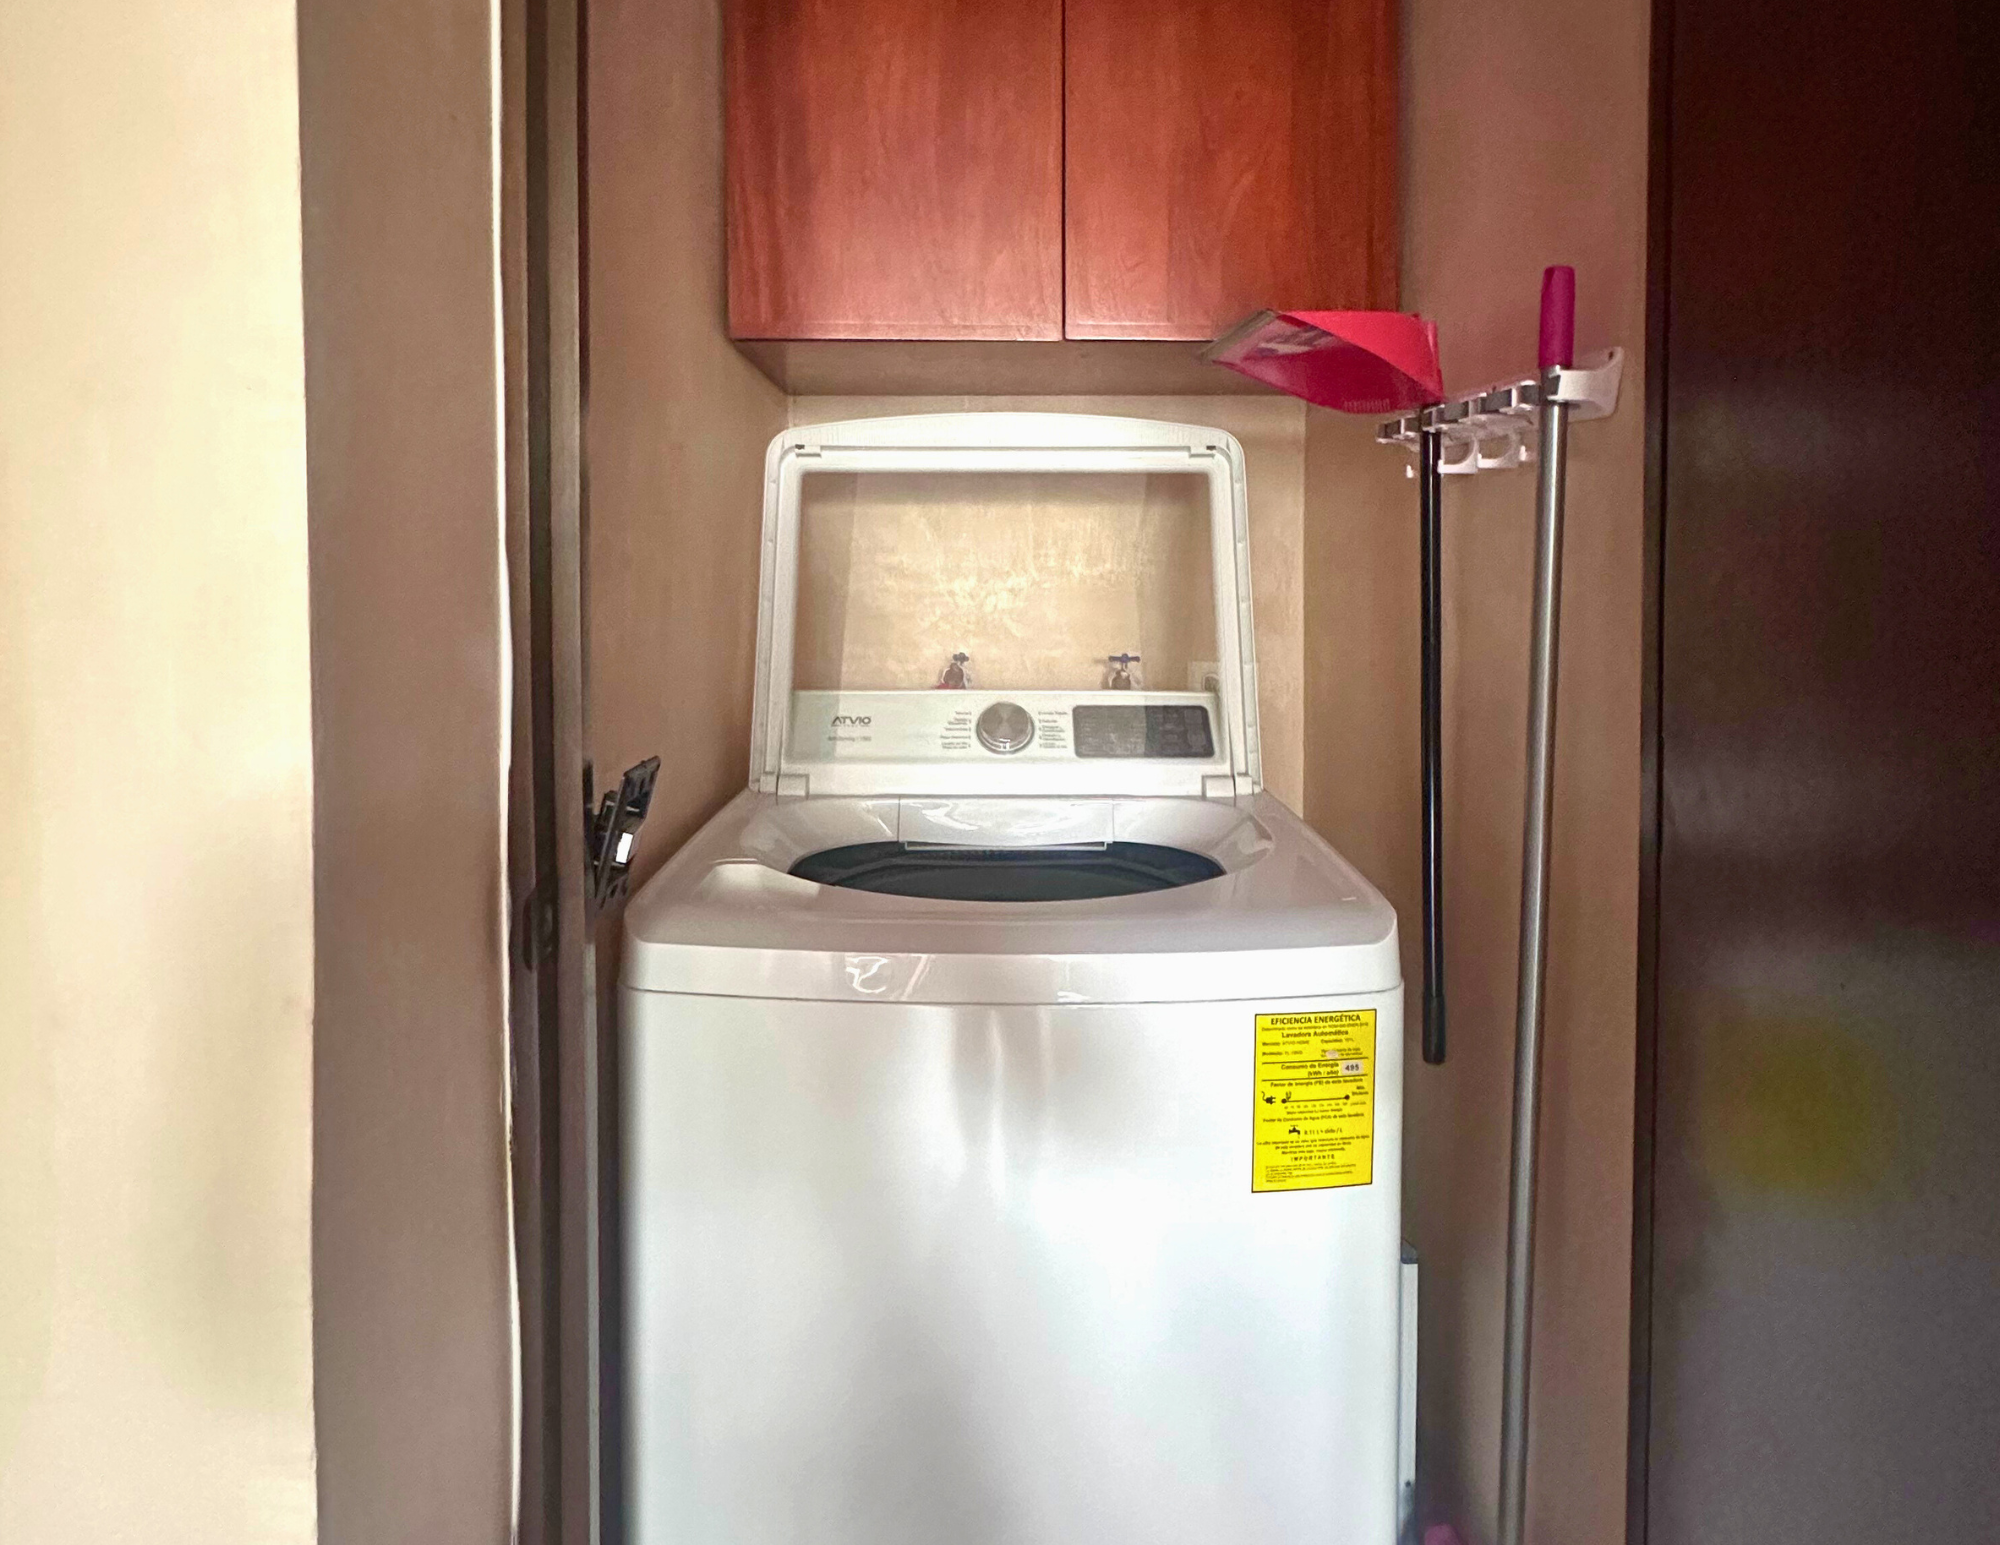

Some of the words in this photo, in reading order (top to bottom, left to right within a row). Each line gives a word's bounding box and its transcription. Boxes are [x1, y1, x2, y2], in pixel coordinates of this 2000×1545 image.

[832, 716, 872, 725] ATVIO
[1270, 1016, 1313, 1026] EFICIENCIA
[1314, 1014, 1361, 1024] ENERGÉTICA
[1281, 1031, 1312, 1039] Lavadora
[1313, 1029, 1349, 1037] Automática
